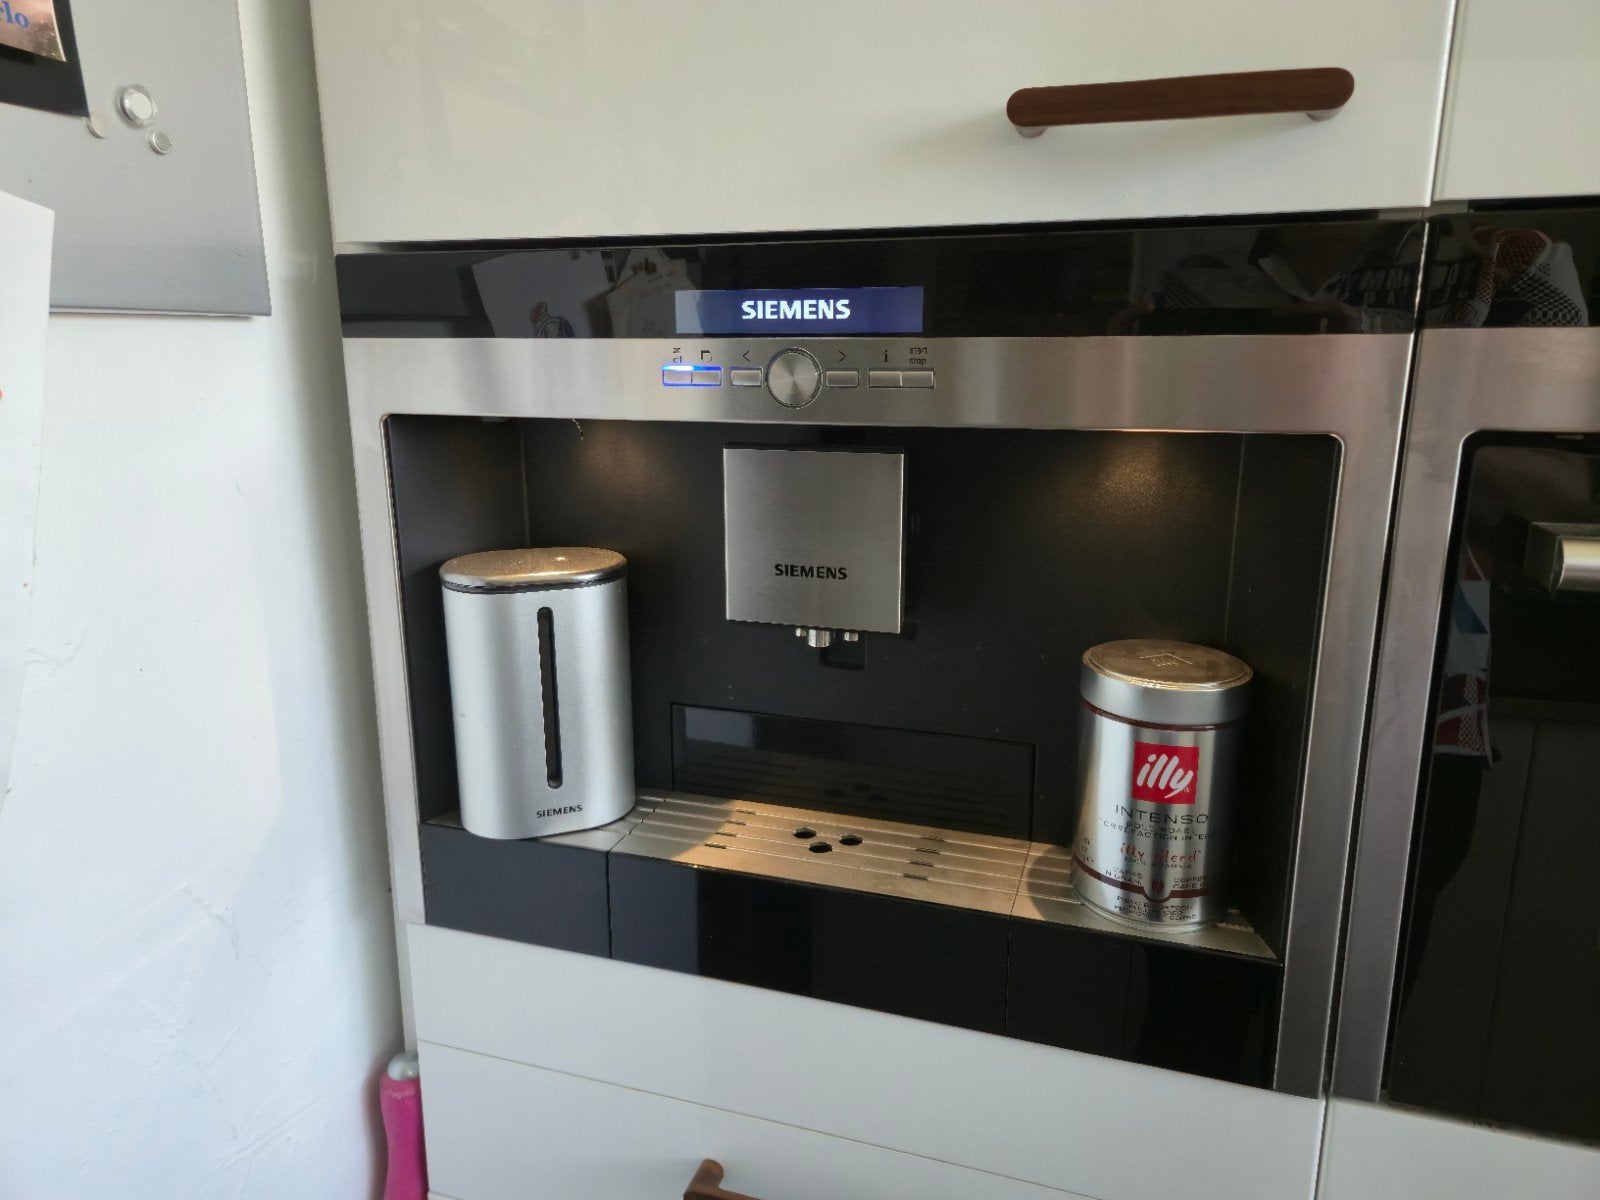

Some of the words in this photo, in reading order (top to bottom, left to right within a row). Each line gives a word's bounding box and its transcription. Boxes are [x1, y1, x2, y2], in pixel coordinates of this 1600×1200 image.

[741, 299, 851, 320] SIEMENS
[909, 346, 928, 355] start
[909, 357, 927, 366] stop
[774, 563, 848, 580] SIEMENS
[1136, 753, 1194, 799] illy
[536, 804, 583, 818] SIEMENS
[1114, 804, 1209, 825] INTENSO
